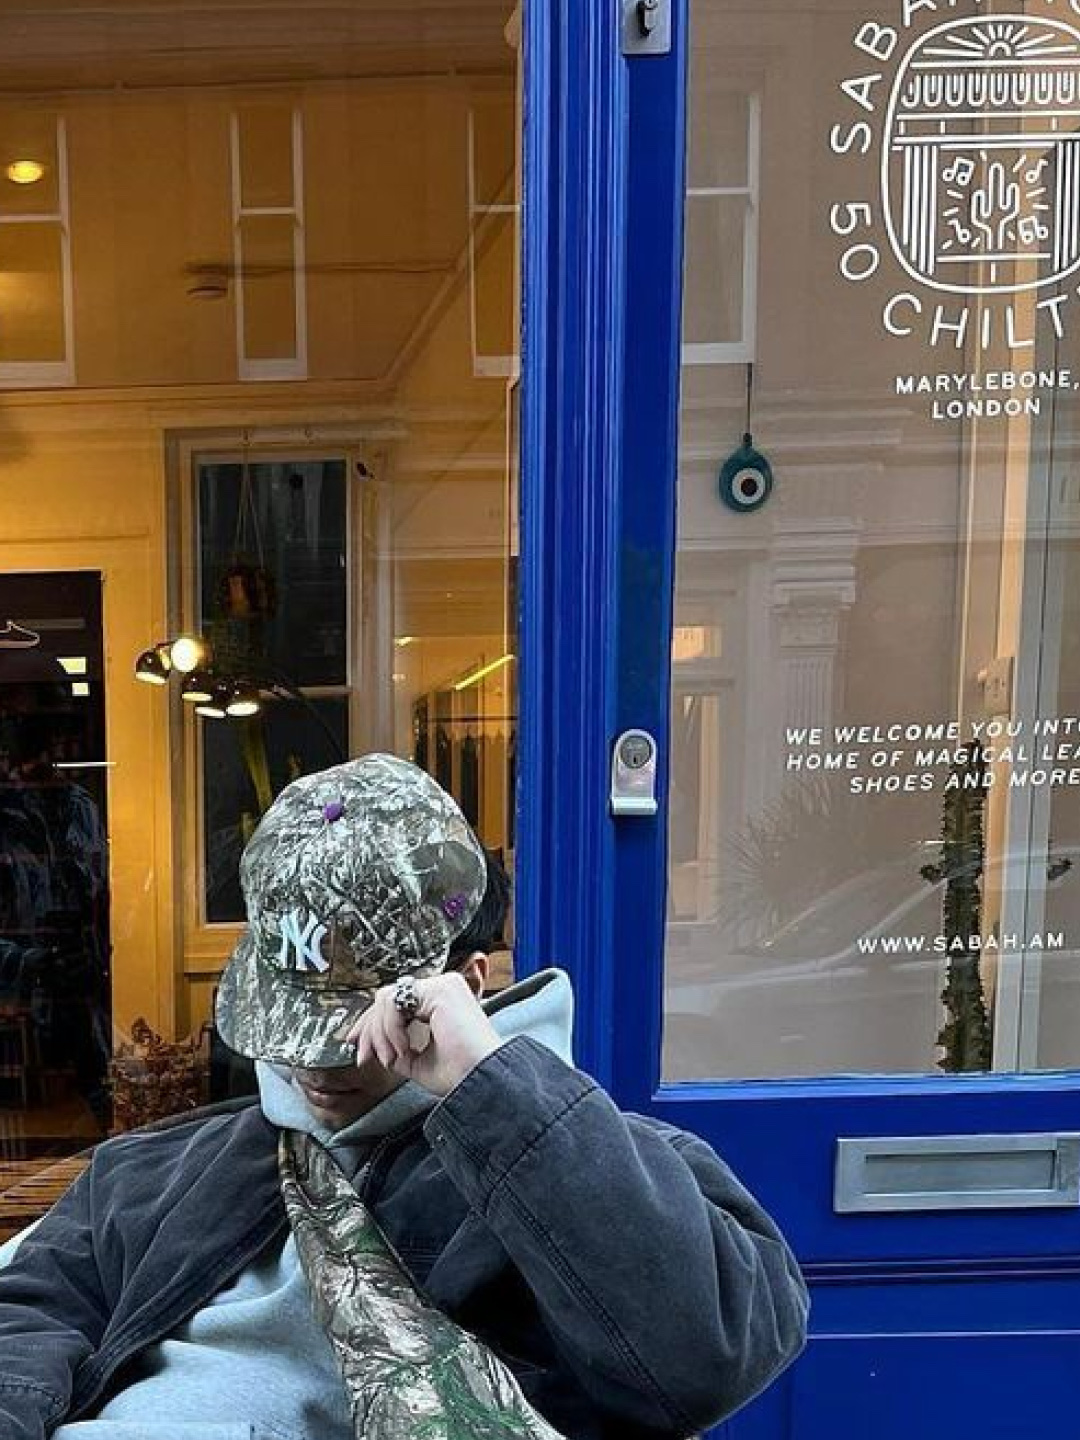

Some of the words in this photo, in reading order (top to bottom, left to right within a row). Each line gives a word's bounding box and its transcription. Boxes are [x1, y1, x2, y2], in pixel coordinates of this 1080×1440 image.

[831, 0, 980, 153] SABA
[883, 285, 1080, 350] CHILT
[895, 370, 1080, 394] MARYLEBONE,
[932, 397, 1041, 419] LONDON
[785, 728, 822, 746] WE
[834, 722, 960, 744] WELCOME
[971, 720, 1022, 738] YOU
[1033, 717, 1080, 736] INT
[786, 752, 860, 771] HOME
[870, 750, 905, 768] OF
[915, 745, 1028, 766] MAGICAL
[850, 773, 935, 794] SHOES
[944, 771, 997, 790] AND
[1009, 767, 1080, 788] MORE
[277, 909, 330, 973] NY
[856, 932, 1065, 954] WWW.SABAH.AM
